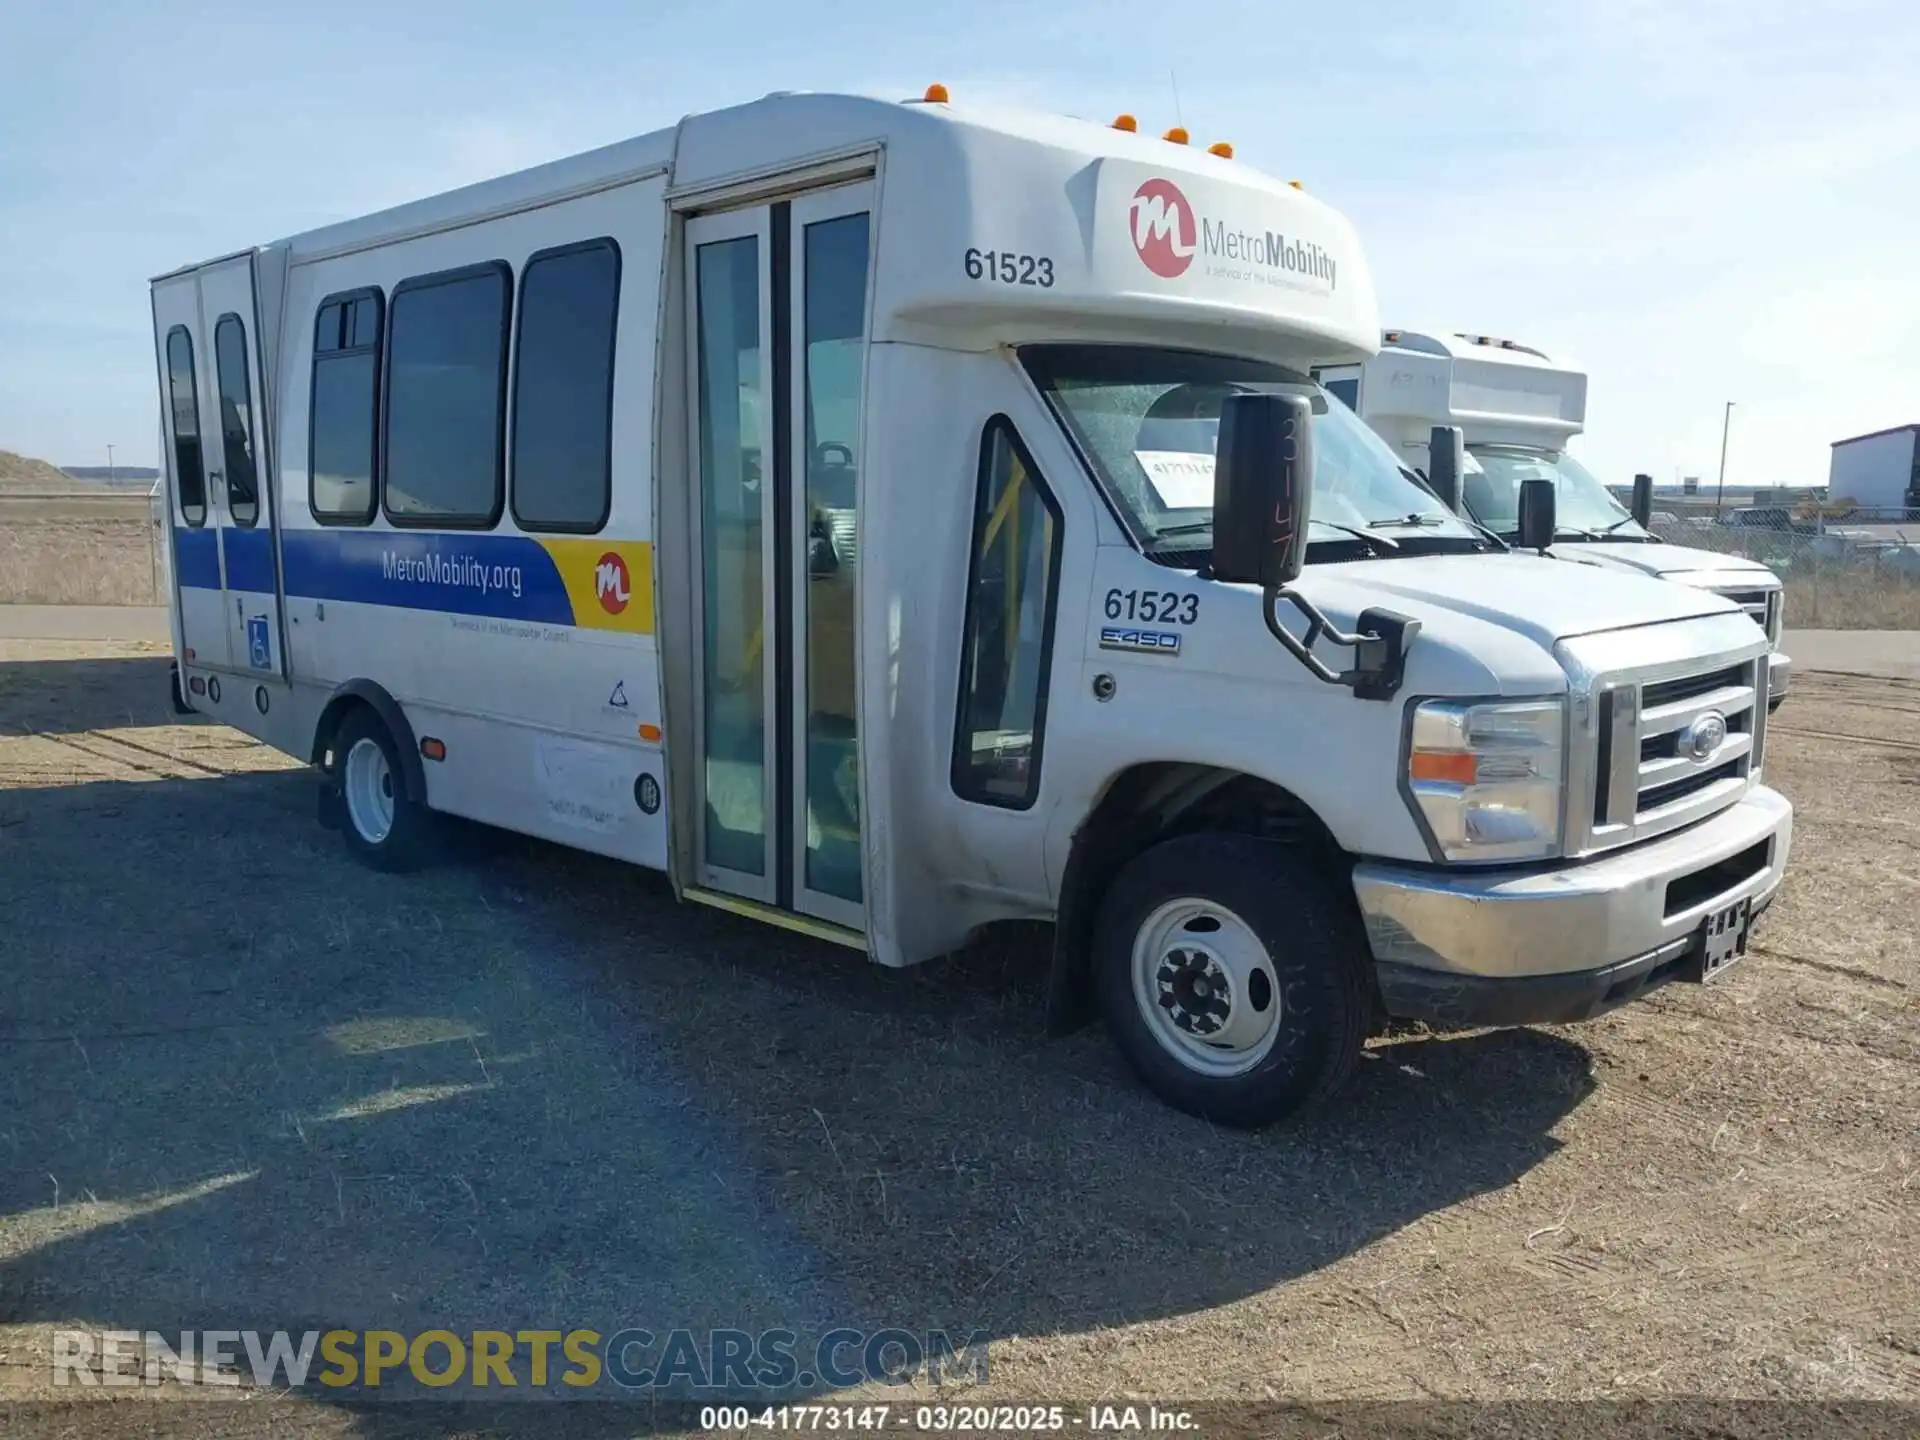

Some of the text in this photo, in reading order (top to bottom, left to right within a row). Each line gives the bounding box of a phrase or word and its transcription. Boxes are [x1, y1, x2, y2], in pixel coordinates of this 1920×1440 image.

[964, 247, 1055, 288] 61523
[1202, 217, 1336, 290] MetroMobility
[383, 551, 521, 598] MetroMobility.org
[1105, 588, 1199, 625] 61523
